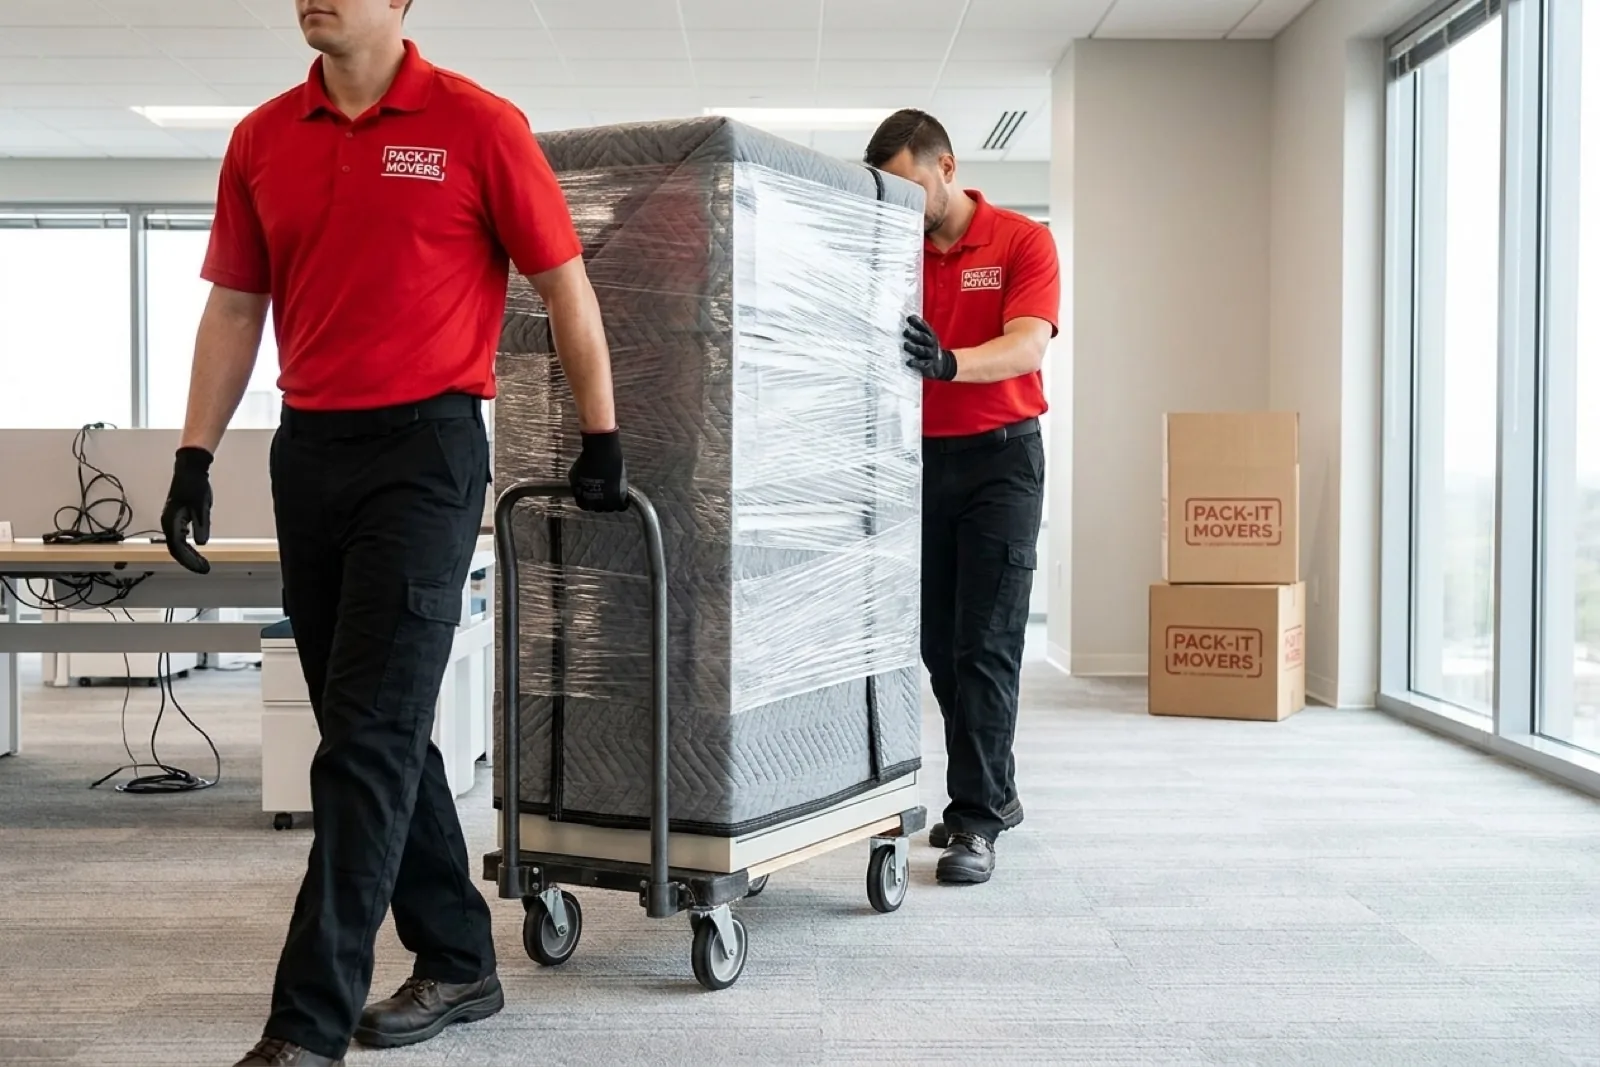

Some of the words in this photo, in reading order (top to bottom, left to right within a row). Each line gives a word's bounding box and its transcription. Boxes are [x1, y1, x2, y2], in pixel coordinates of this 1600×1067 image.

[386, 162, 440, 176] MOVERS
[1193, 505, 1273, 521] PACK-IT
[1193, 524, 1273, 538] MOVERS
[1174, 633, 1254, 651] PACK-IT
[1173, 653, 1253, 670] MOVERS
